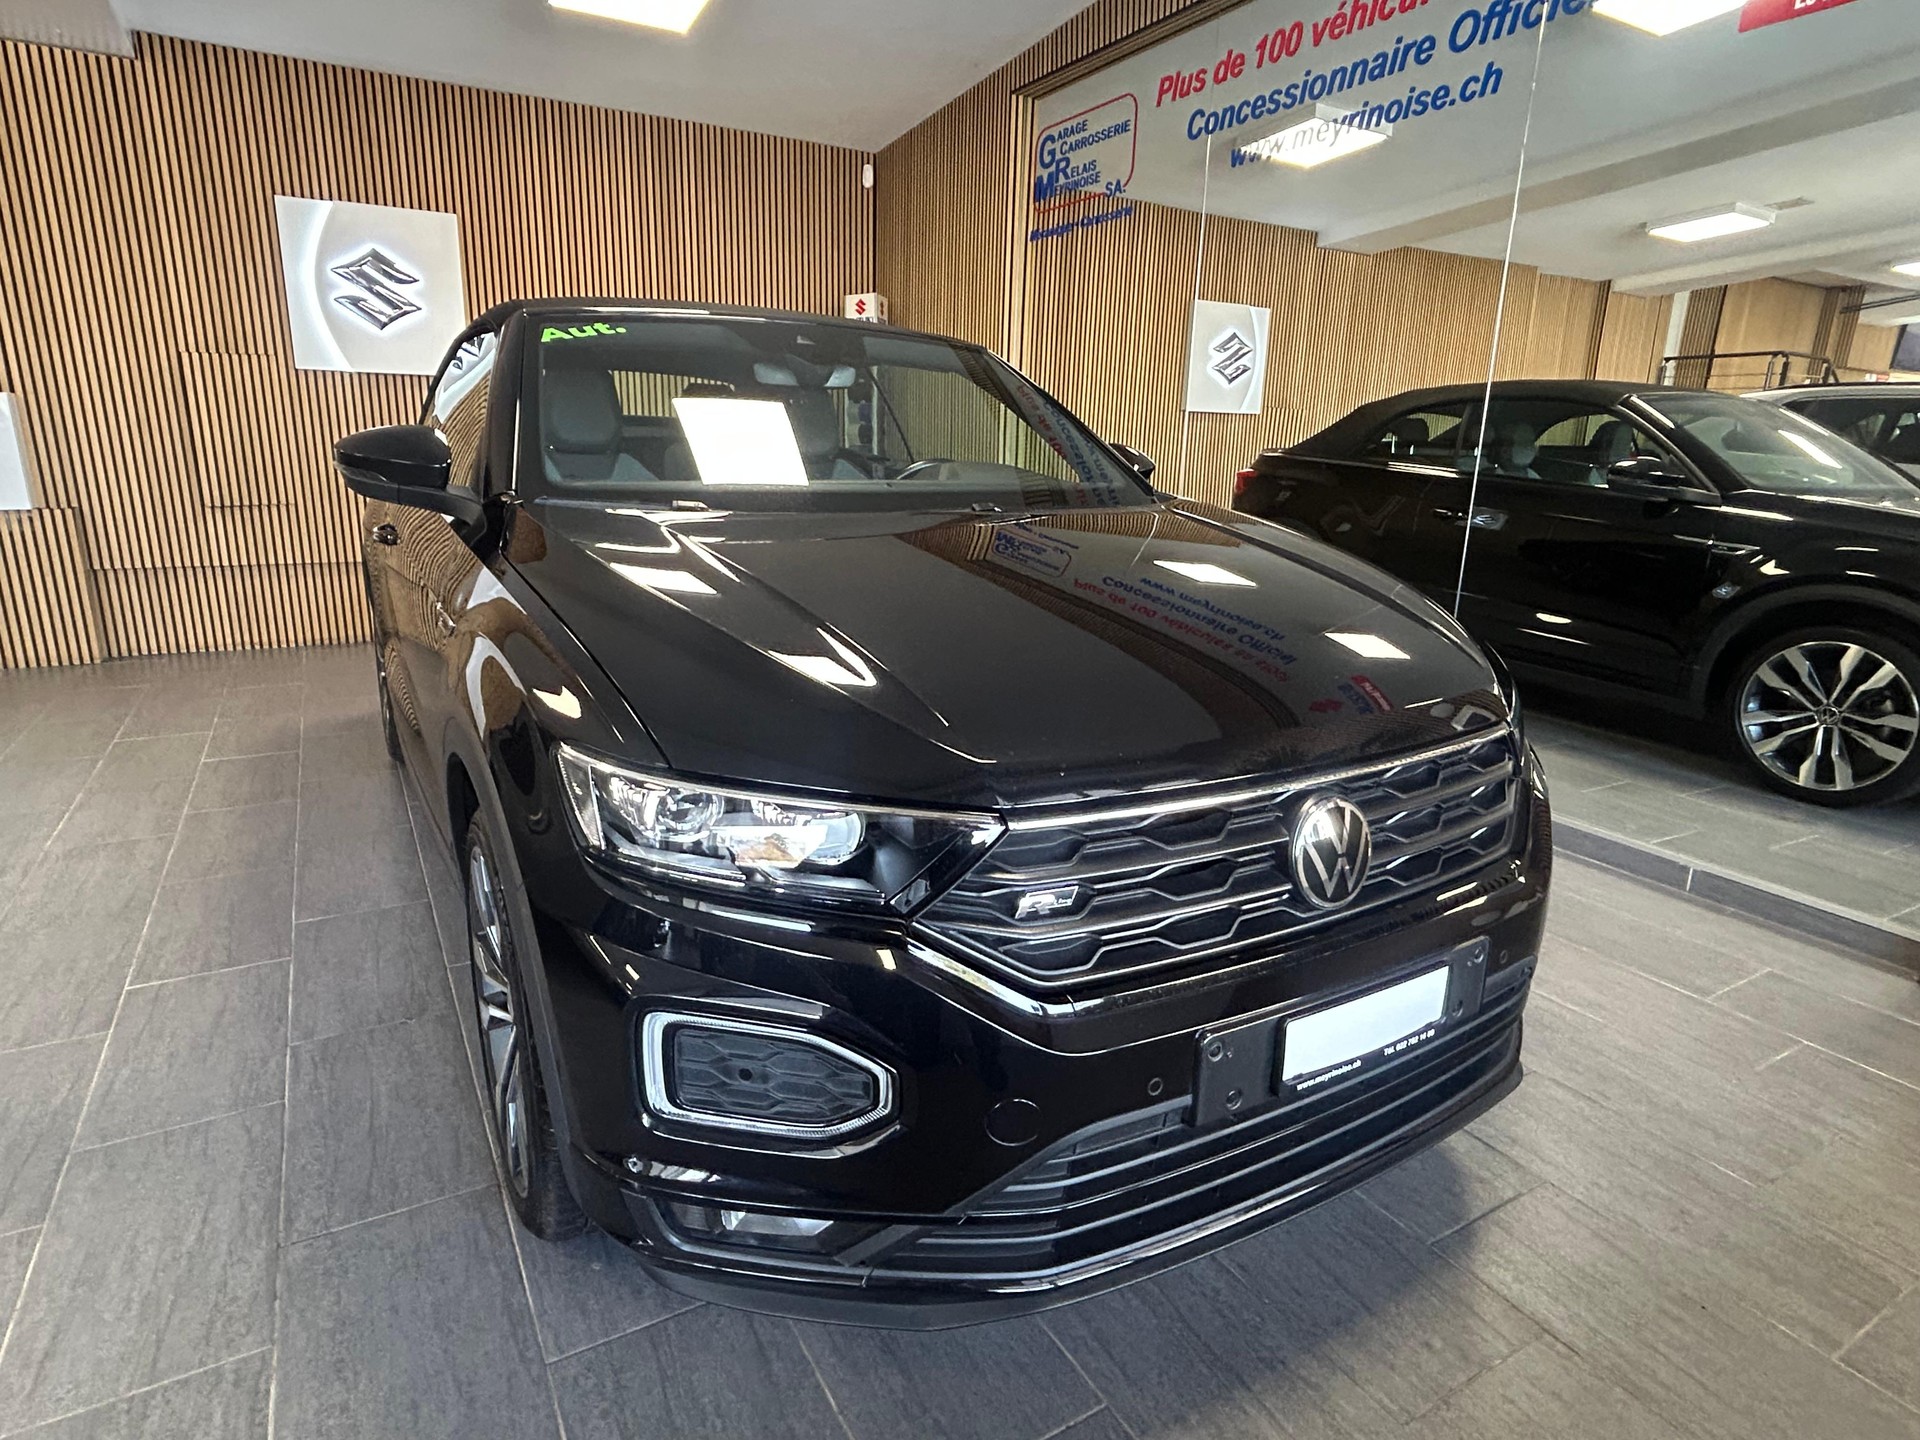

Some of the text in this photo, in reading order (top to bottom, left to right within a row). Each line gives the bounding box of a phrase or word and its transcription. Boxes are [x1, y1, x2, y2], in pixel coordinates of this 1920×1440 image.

[1156, 0, 1429, 108] Plus de 100 véhicu
[1186, 34, 1437, 141] Concessionnaire
[1230, 60, 1504, 168] www.meyrinoise.ch
[1059, 119, 1132, 156] CARROSSERIE
[1034, 170, 1102, 203] MEYRINOISE
[1054, 156, 1098, 185] RELAIS
[1105, 178, 1128, 199] SA.
[540, 322, 627, 343] Aut.
